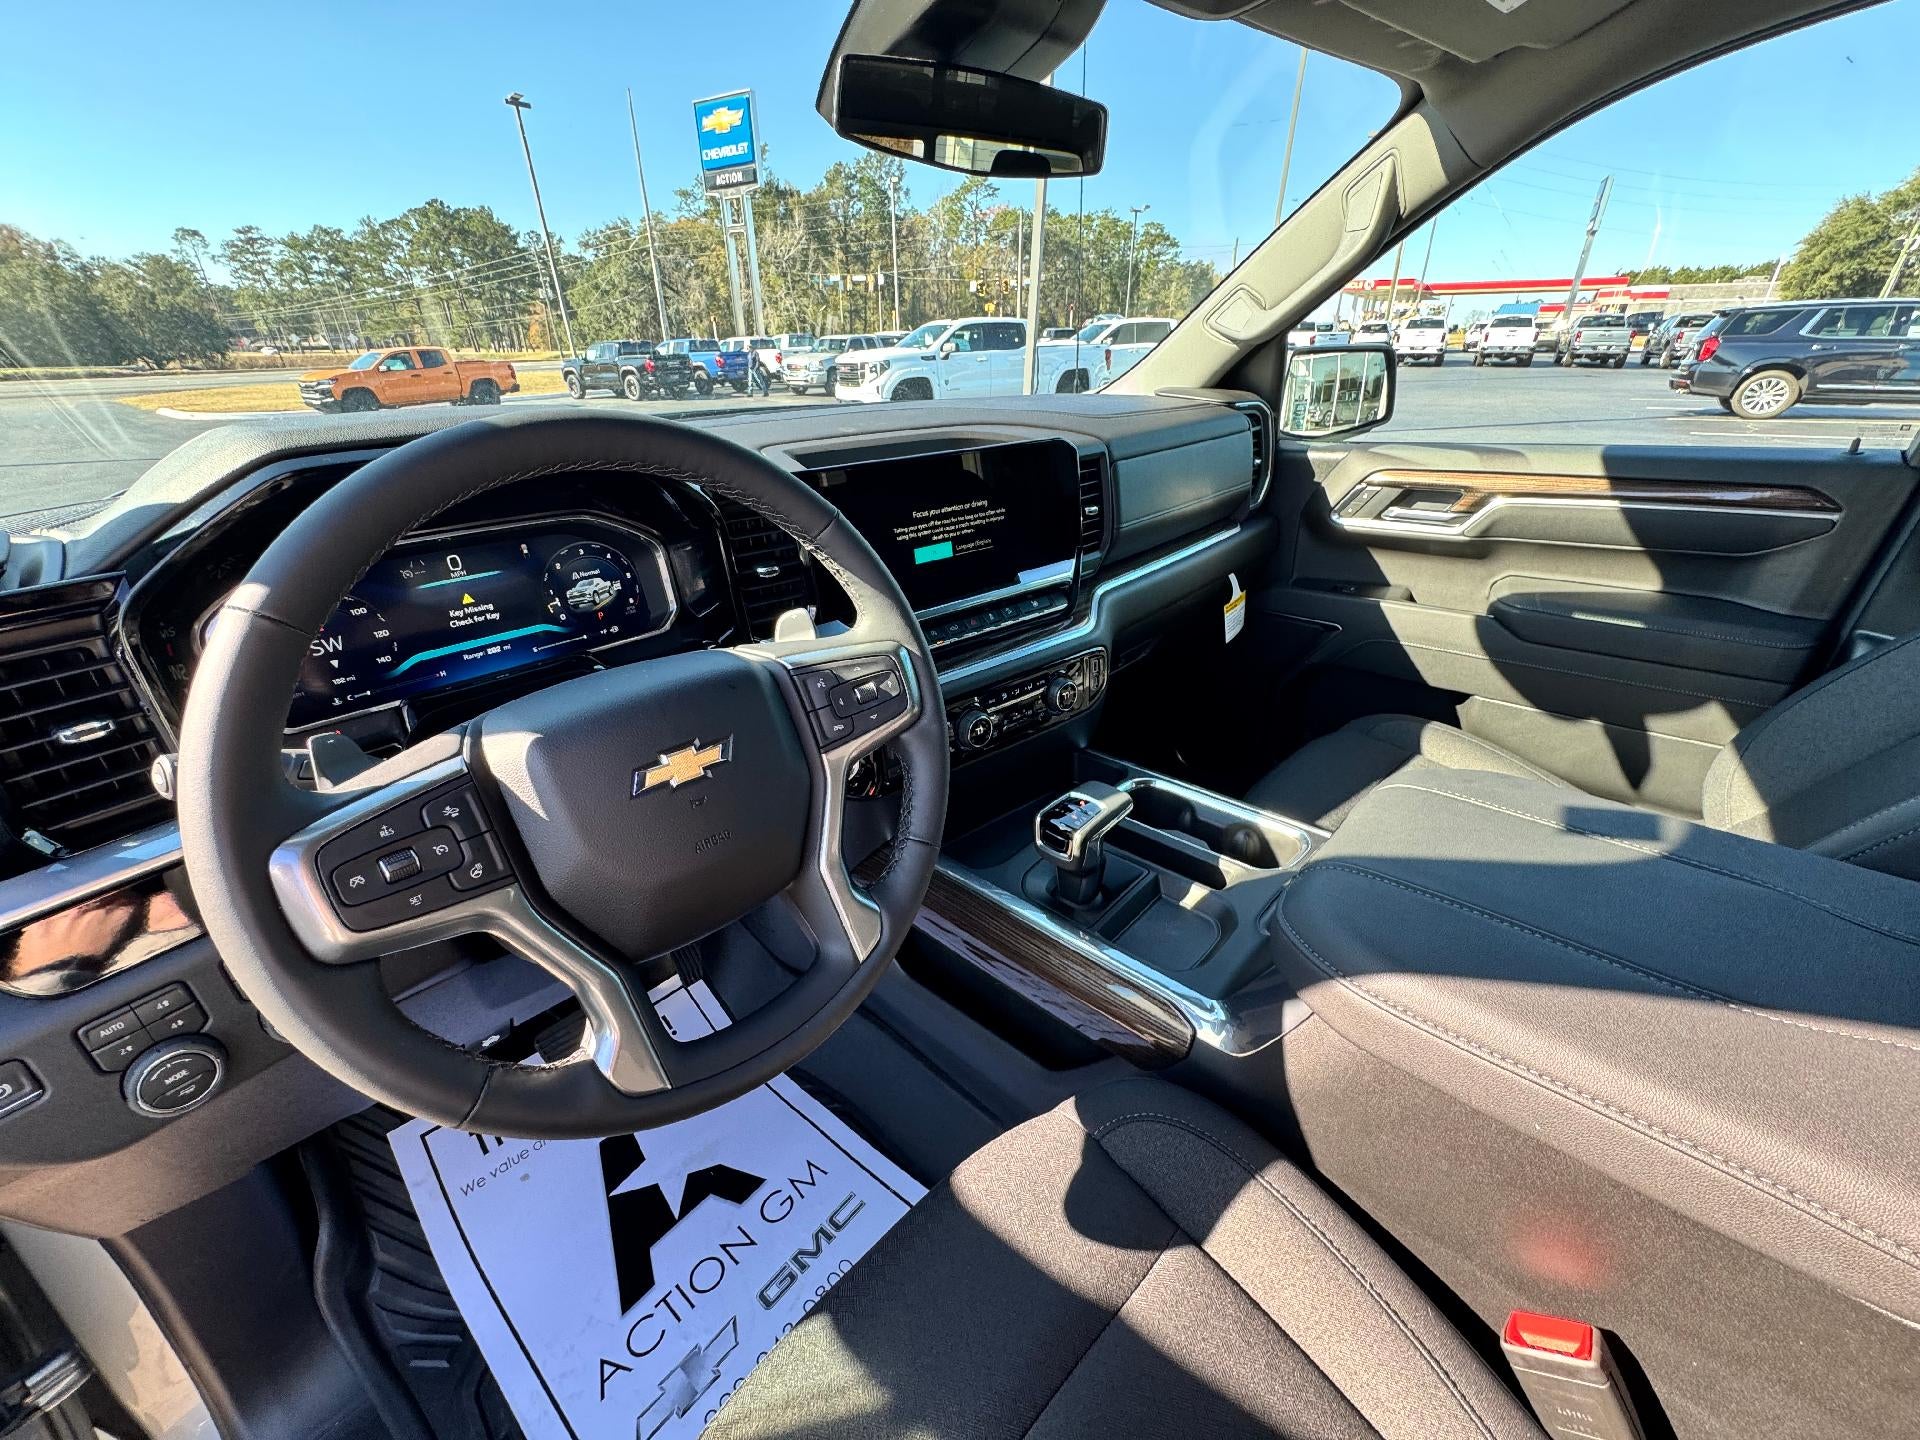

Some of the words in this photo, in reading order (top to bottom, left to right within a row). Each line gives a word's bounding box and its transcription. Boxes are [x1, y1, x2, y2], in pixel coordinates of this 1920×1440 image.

[703, 142, 748, 160] CHEVROLET
[716, 171, 743, 185] ACTION
[446, 554, 462, 571] 0
[555, 562, 561, 570] 2
[450, 569, 467, 578] MPH
[579, 568, 601, 578] Normal
[350, 607, 367, 616] 100
[449, 609, 463, 618] Key
[464, 603, 494, 614] Missing
[597, 611, 604, 620] P
[449, 618, 473, 628] Check
[474, 613, 485, 622] for
[486, 612, 500, 621] Key
[373, 629, 390, 639] 120
[310, 635, 342, 656] SW
[375, 655, 392, 663] 140
[346, 674, 356, 682] mi
[379, 828, 395, 838] RES
[409, 894, 422, 905] SET
[100, 1022, 125, 1038] AUTO
[164, 1069, 191, 1086] MODE
[460, 1175, 487, 1197] We
[489, 1149, 529, 1179] value
[755, 1190, 867, 1312] GMC
[600, 1225, 758, 1402] ACTION
[760, 1159, 829, 1224] GM
